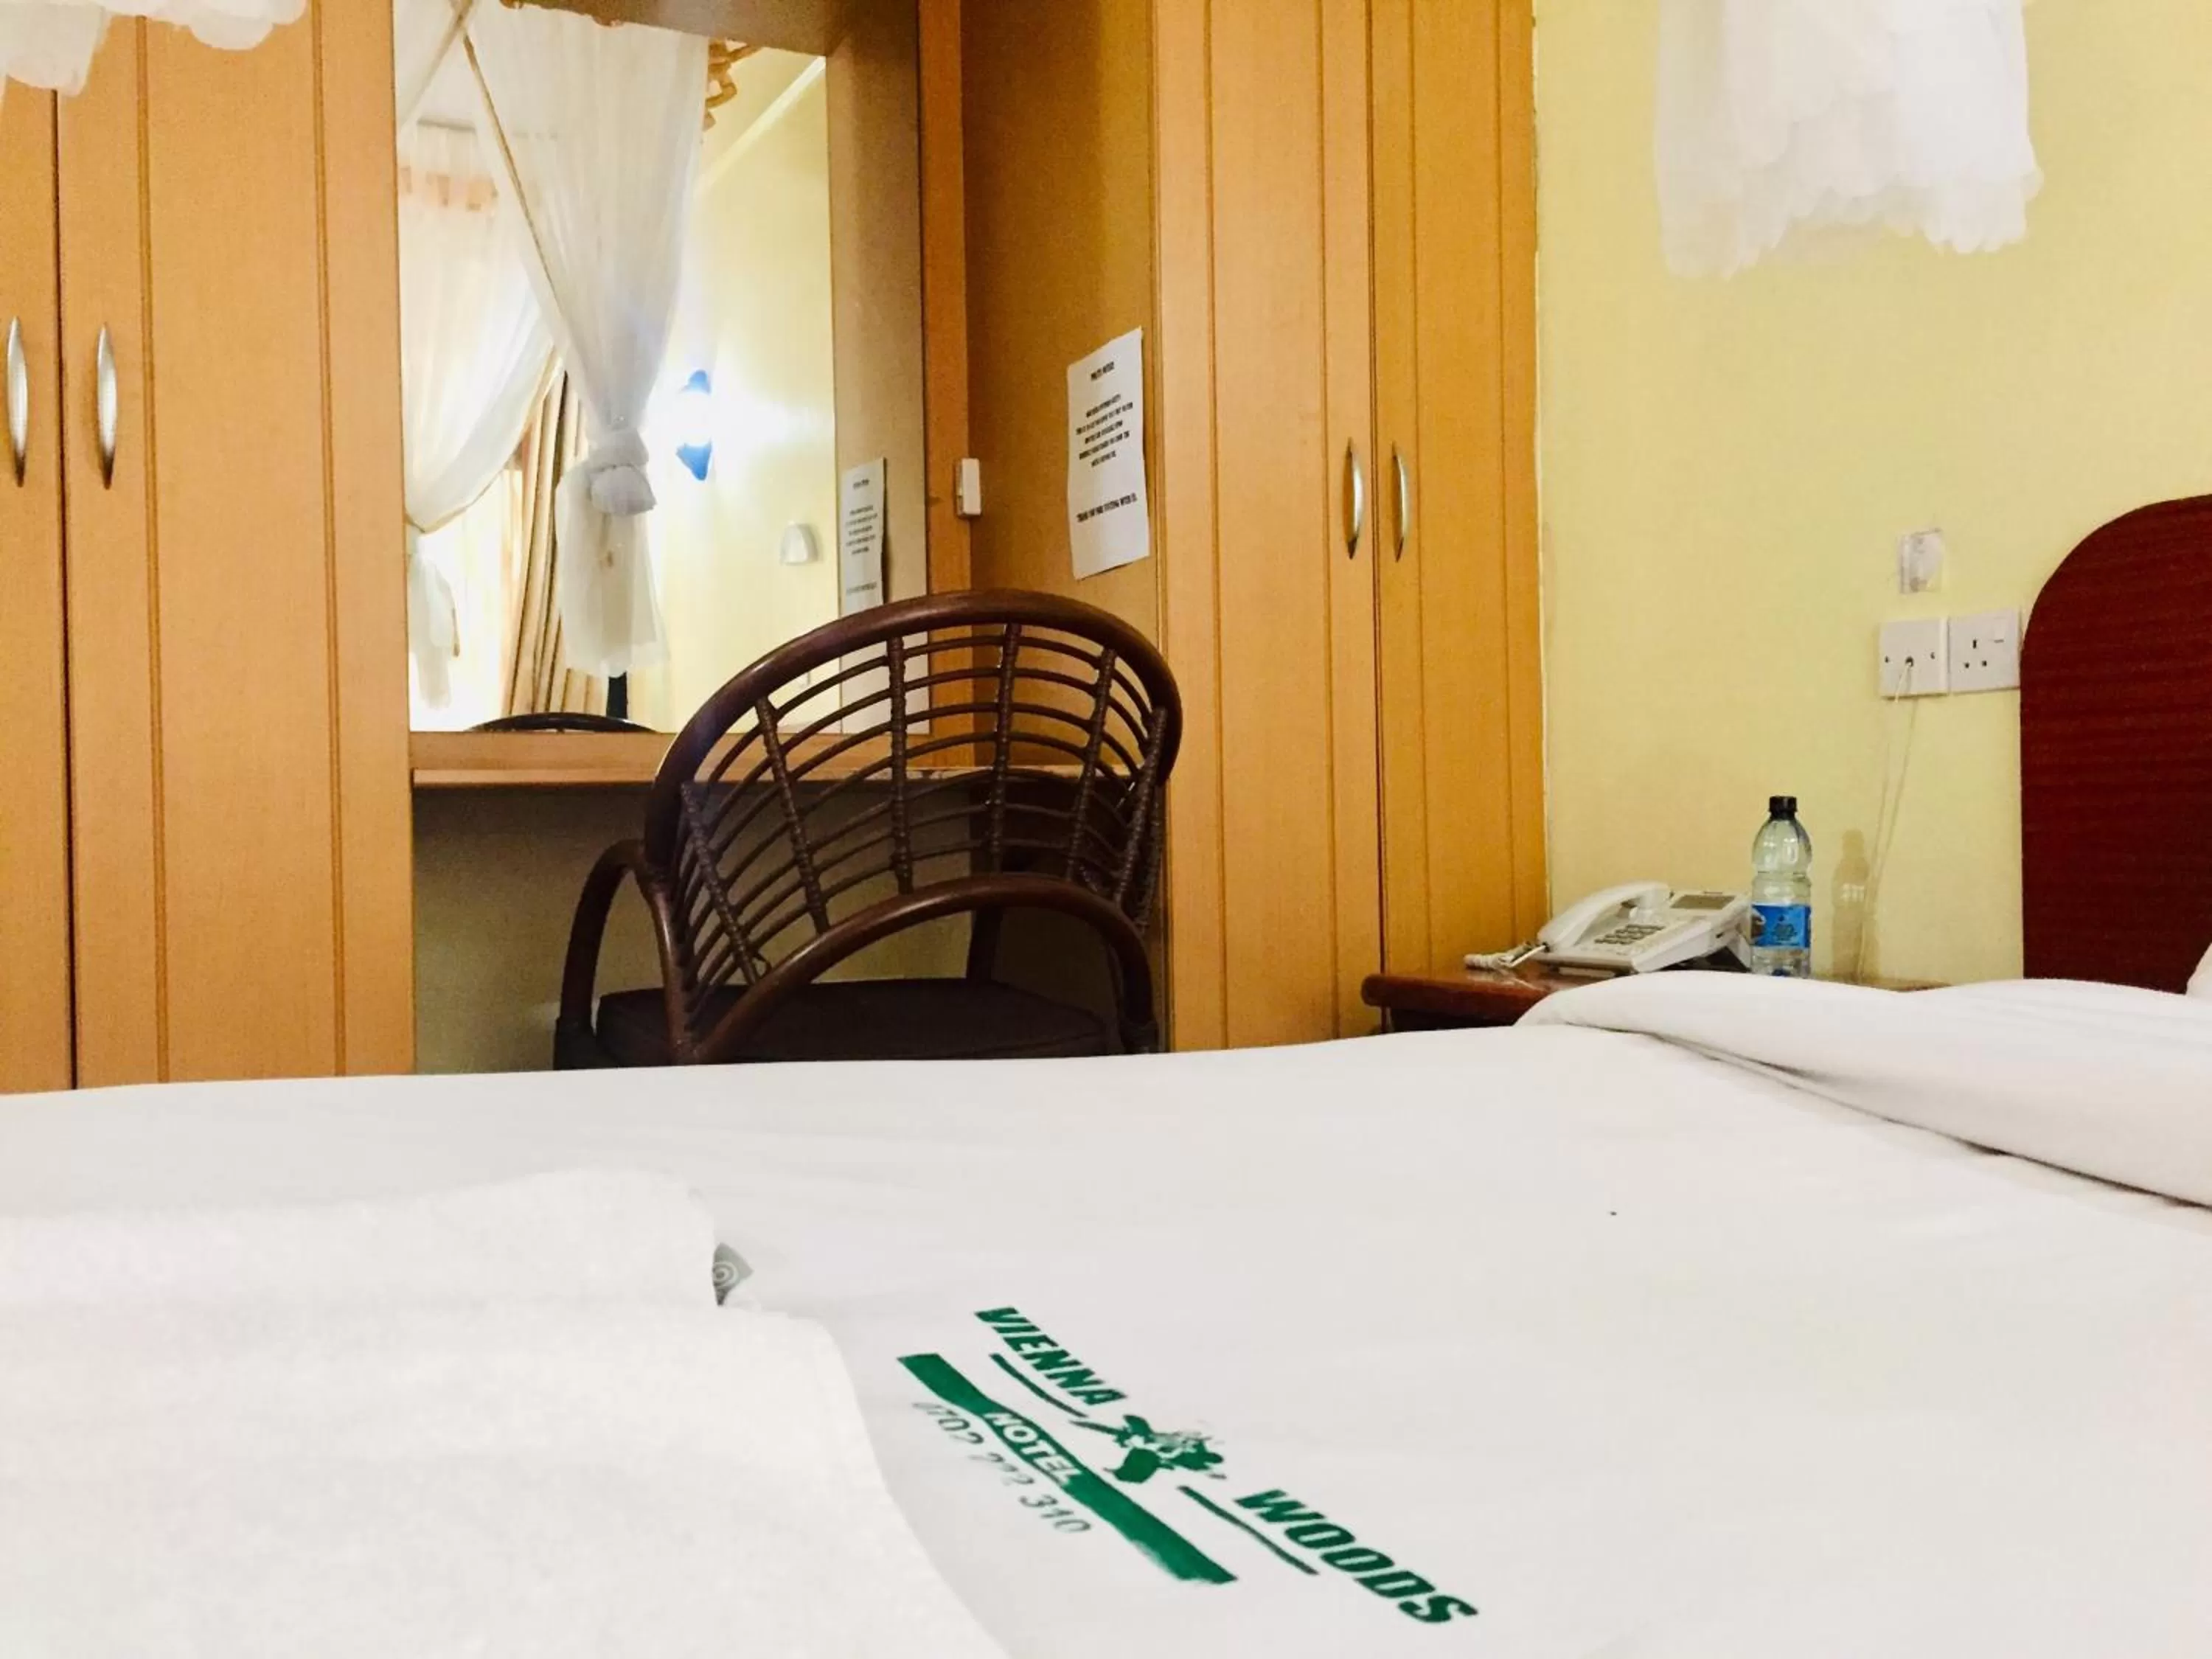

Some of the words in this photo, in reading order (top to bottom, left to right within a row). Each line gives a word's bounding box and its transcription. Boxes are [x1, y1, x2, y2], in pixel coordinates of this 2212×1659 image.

[974, 1307, 1127, 1405] VIENNA
[1234, 1489, 1478, 1624] WOODS
[984, 1412, 1082, 1485] HOTEL
[1018, 1495, 1092, 1534] 310
